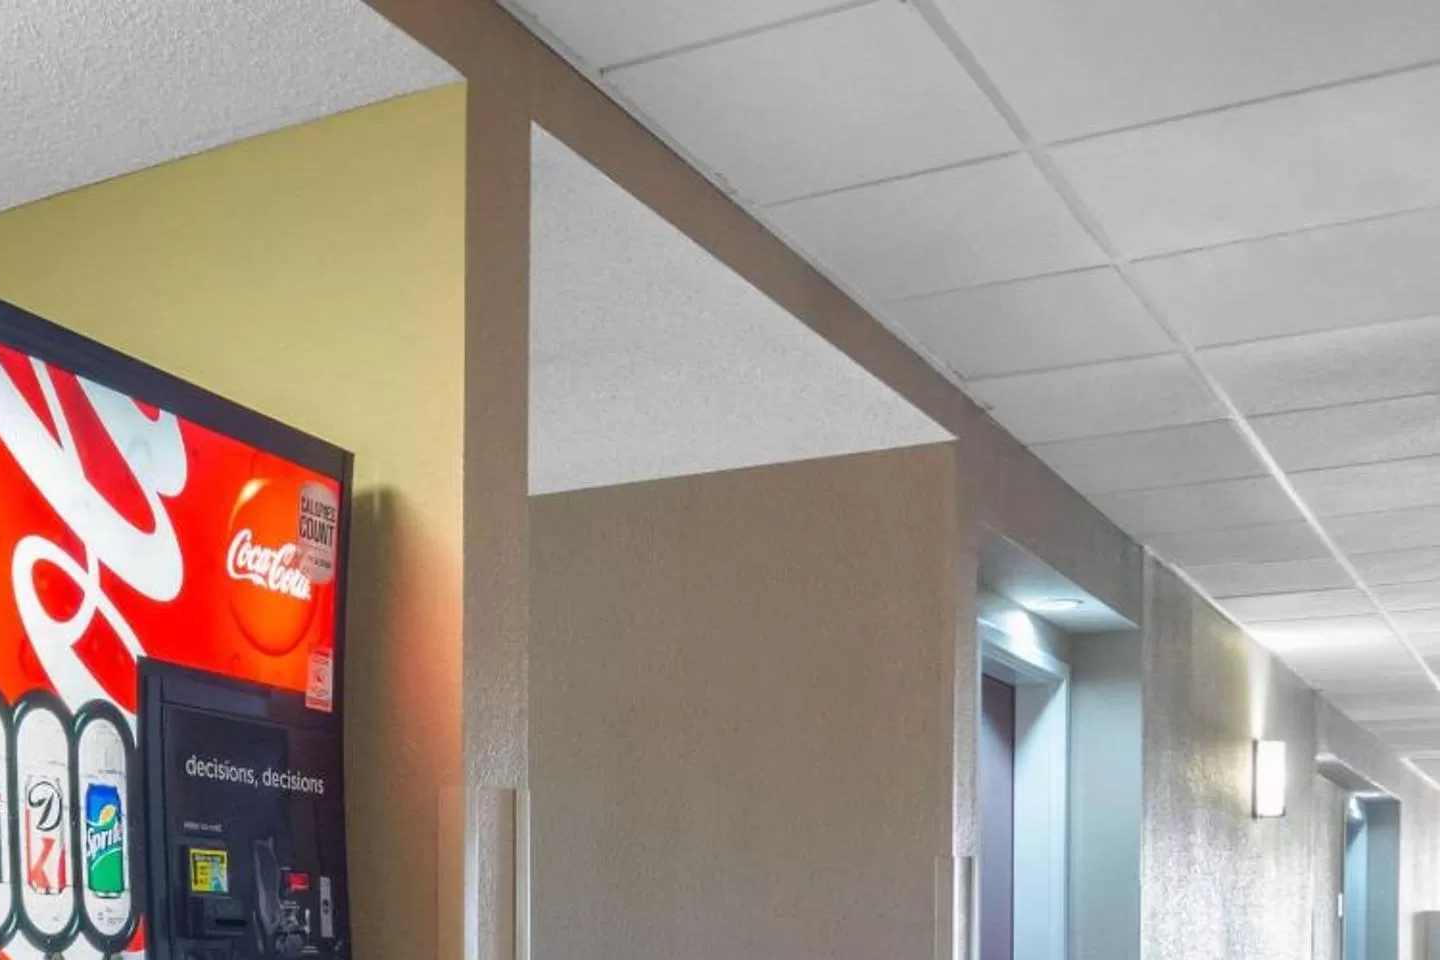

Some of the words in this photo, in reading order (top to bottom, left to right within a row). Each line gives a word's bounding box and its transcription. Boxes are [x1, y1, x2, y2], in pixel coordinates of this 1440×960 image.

[299, 514, 334, 549] COUNT
[185, 754, 259, 789] decisions,
[262, 767, 325, 795] decisions
